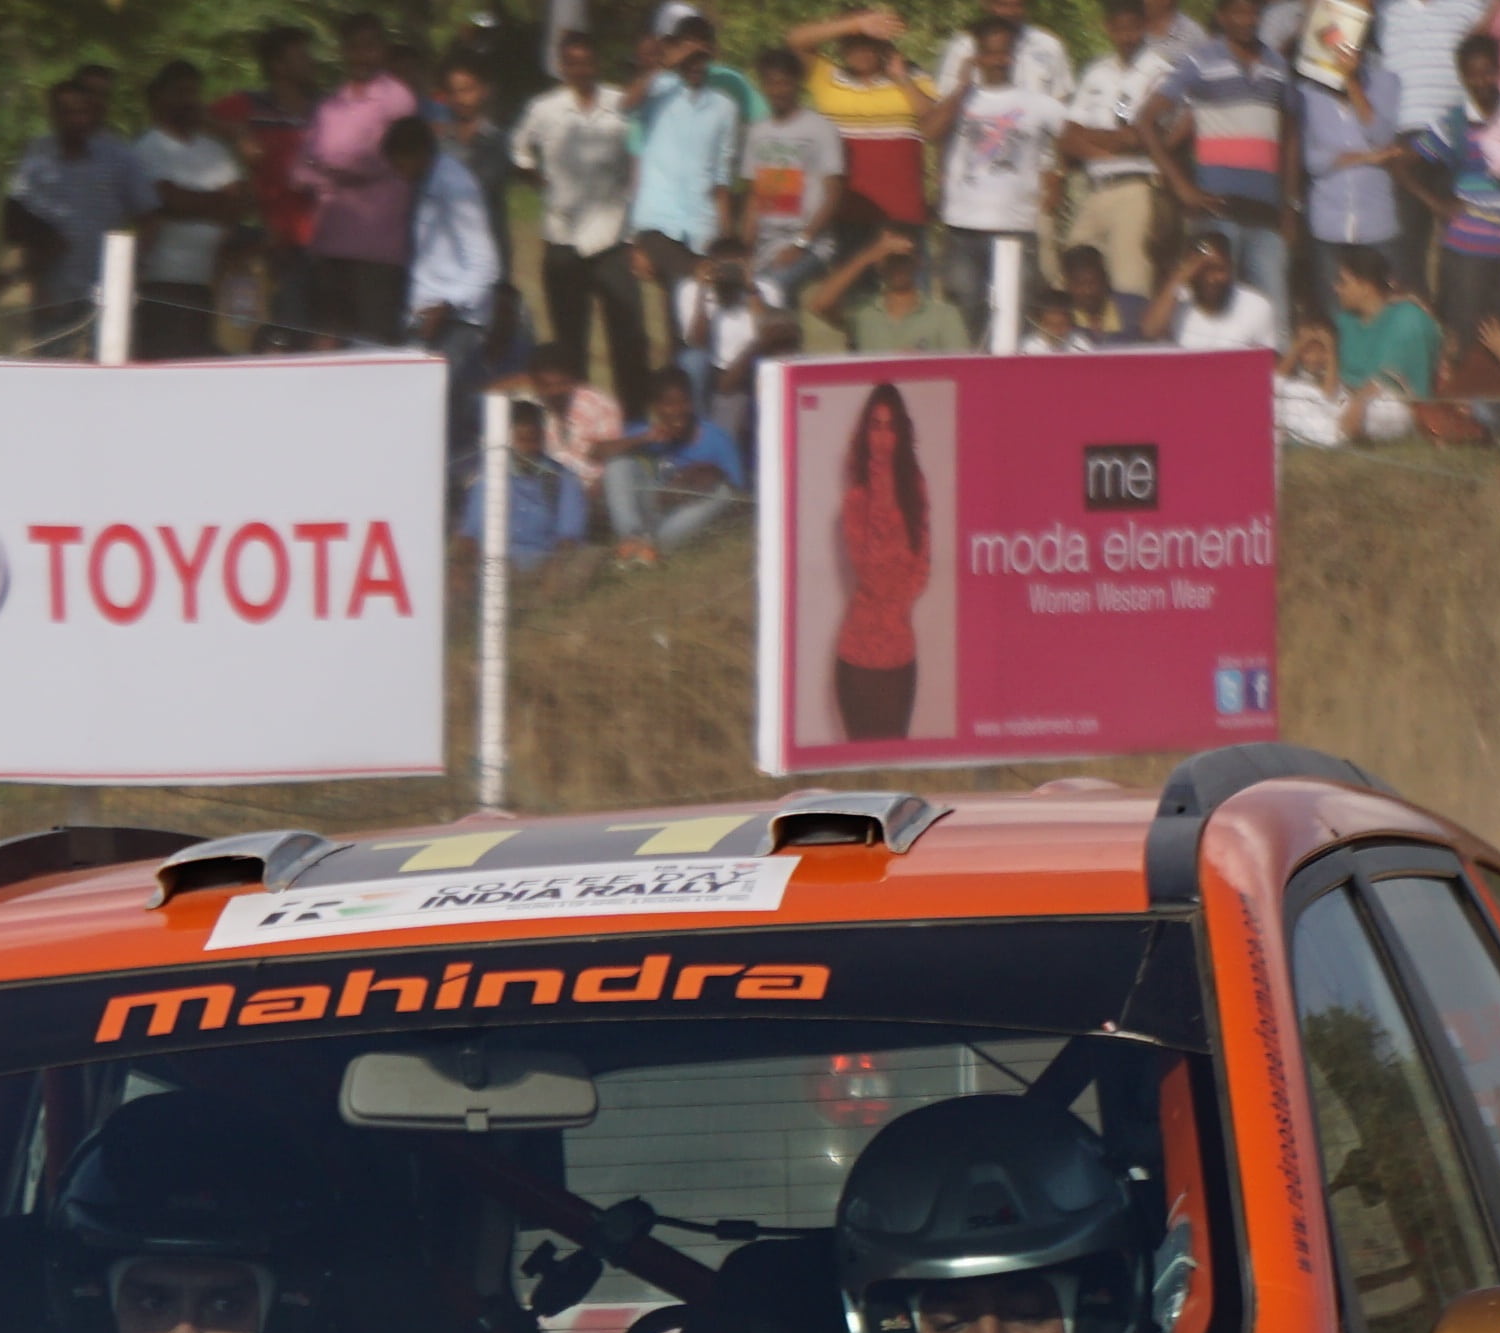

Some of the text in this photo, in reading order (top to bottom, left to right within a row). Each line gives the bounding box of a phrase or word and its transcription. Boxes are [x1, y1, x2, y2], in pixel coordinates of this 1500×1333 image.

[1087, 455, 1153, 499] me
[970, 514, 1274, 576] moda elementi
[26, 519, 414, 626] TOYOTA
[419, 887, 561, 910] INDIA
[578, 880, 742, 898] RALLY
[437, 869, 758, 894] COFFEE DAY
